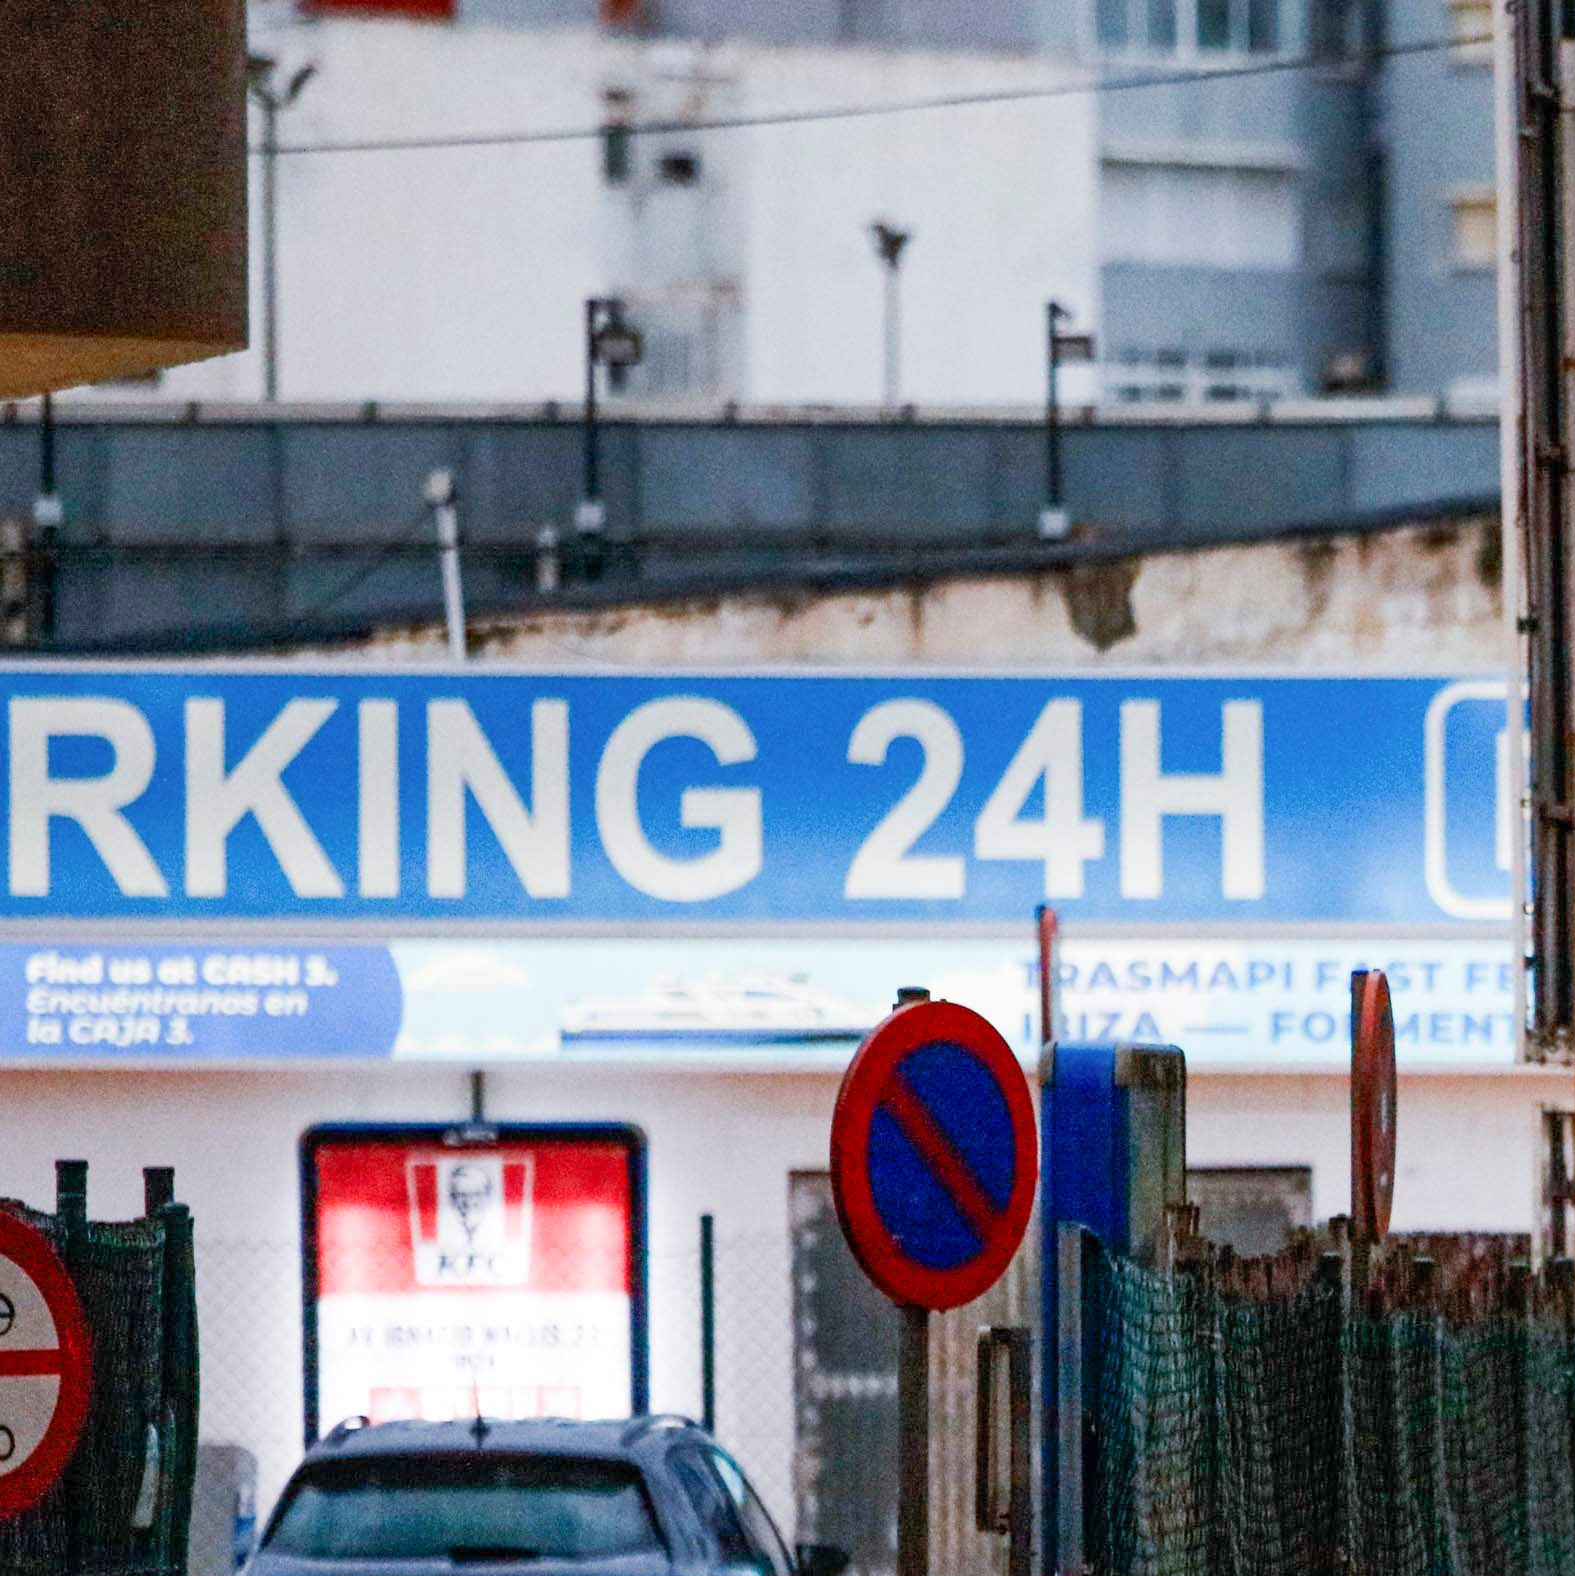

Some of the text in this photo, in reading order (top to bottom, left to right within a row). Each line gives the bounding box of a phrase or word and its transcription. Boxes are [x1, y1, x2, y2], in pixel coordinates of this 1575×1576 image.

[7, 696, 765, 903] RKING
[844, 697, 1265, 901] 24H
[26, 951, 104, 985] Find
[109, 957, 151, 985] us
[157, 955, 196, 985] at
[1316, 961, 1442, 992] FST
[264, 989, 309, 1016] en
[27, 1015, 62, 1044] la
[69, 1015, 161, 1047] CAJA
[1271, 1011, 1516, 1043] FOMENT
